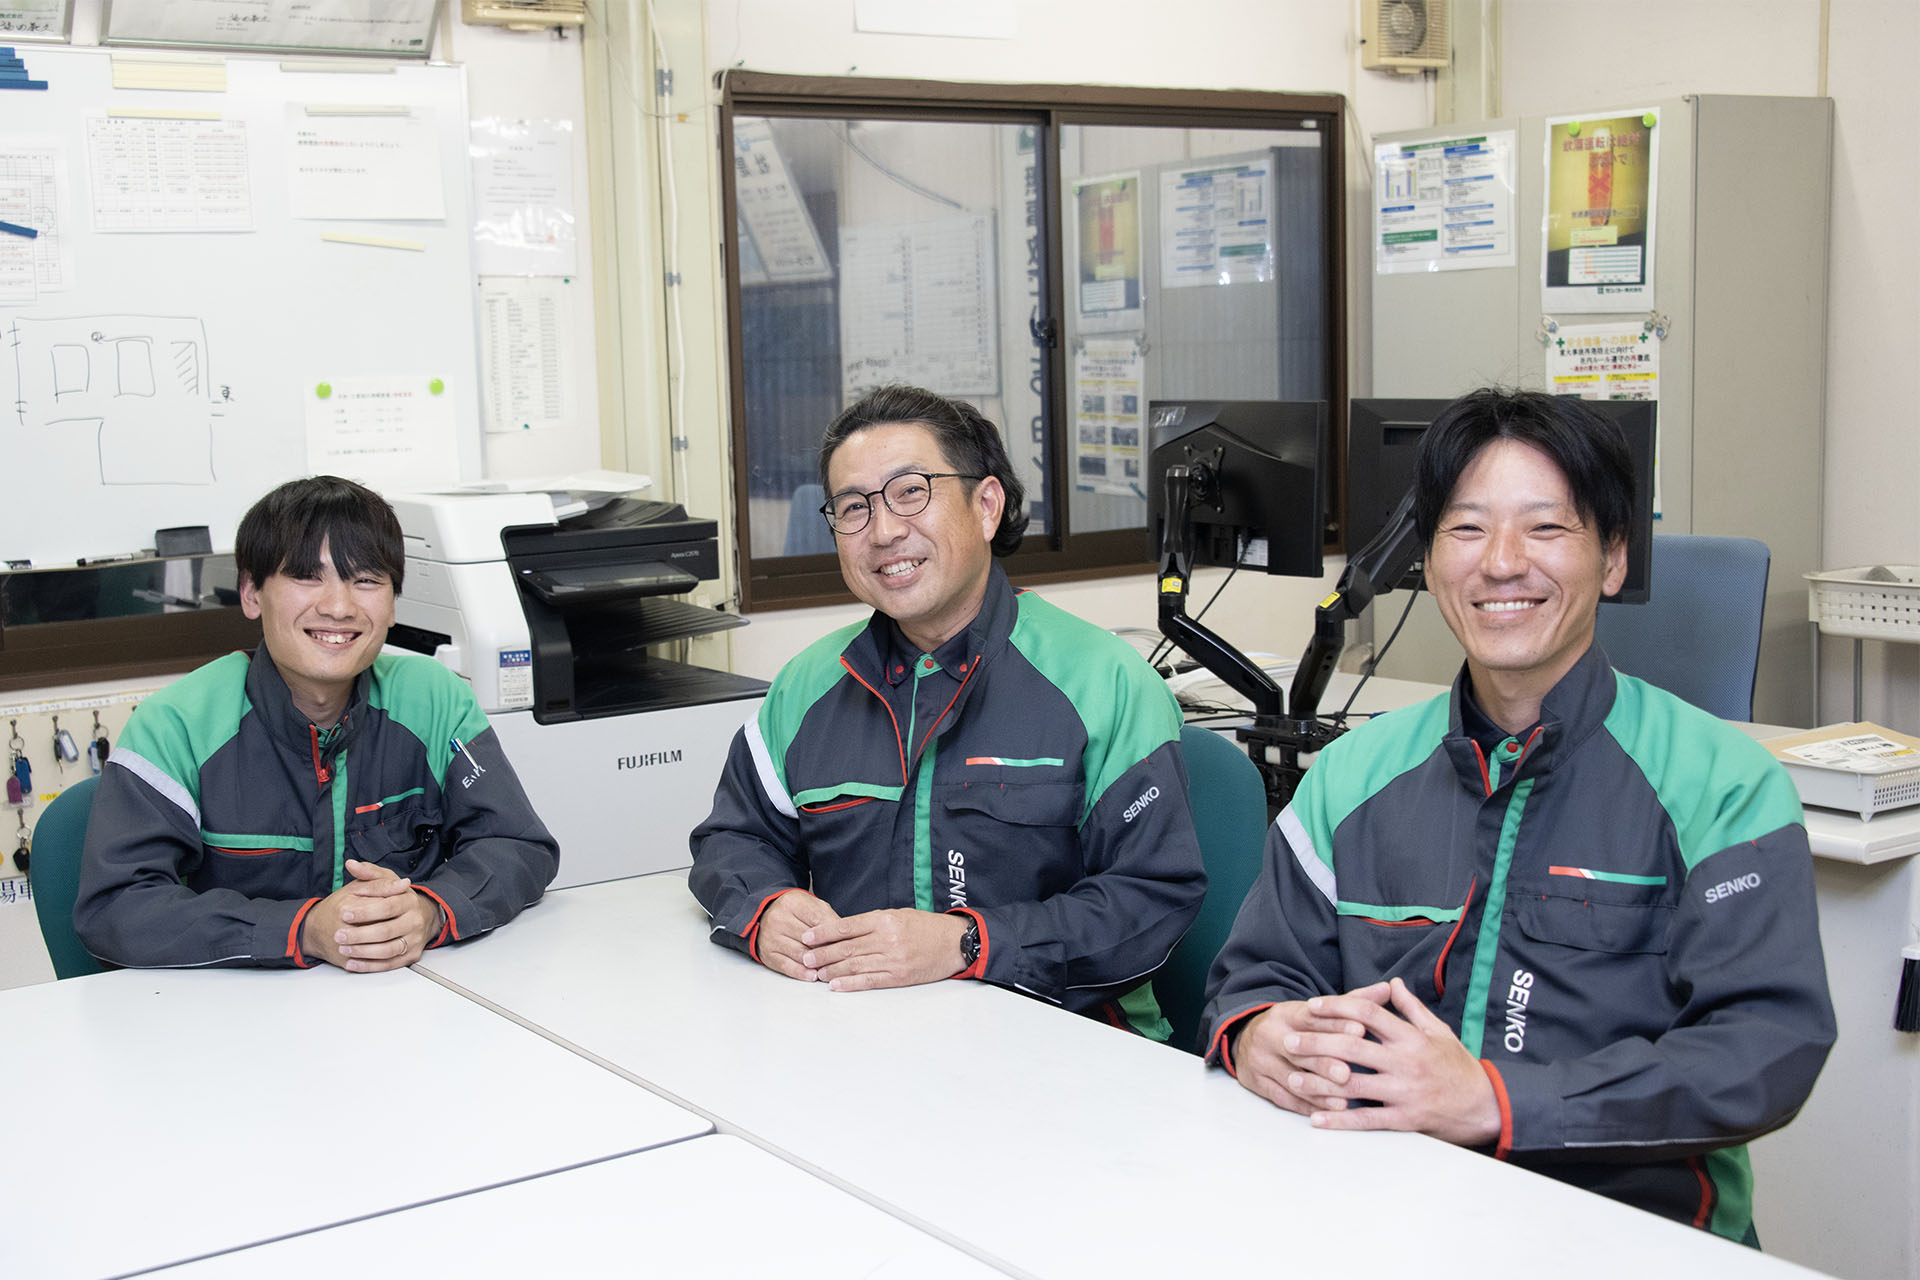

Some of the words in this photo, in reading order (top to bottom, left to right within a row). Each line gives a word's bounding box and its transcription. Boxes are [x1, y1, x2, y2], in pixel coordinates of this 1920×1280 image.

[617, 749, 682, 770] FUJIFILM
[1123, 786, 1160, 822] SENKO
[948, 849, 968, 908] SENK
[1705, 872, 1761, 904] SENKO
[1504, 969, 1534, 1053] SENKO
